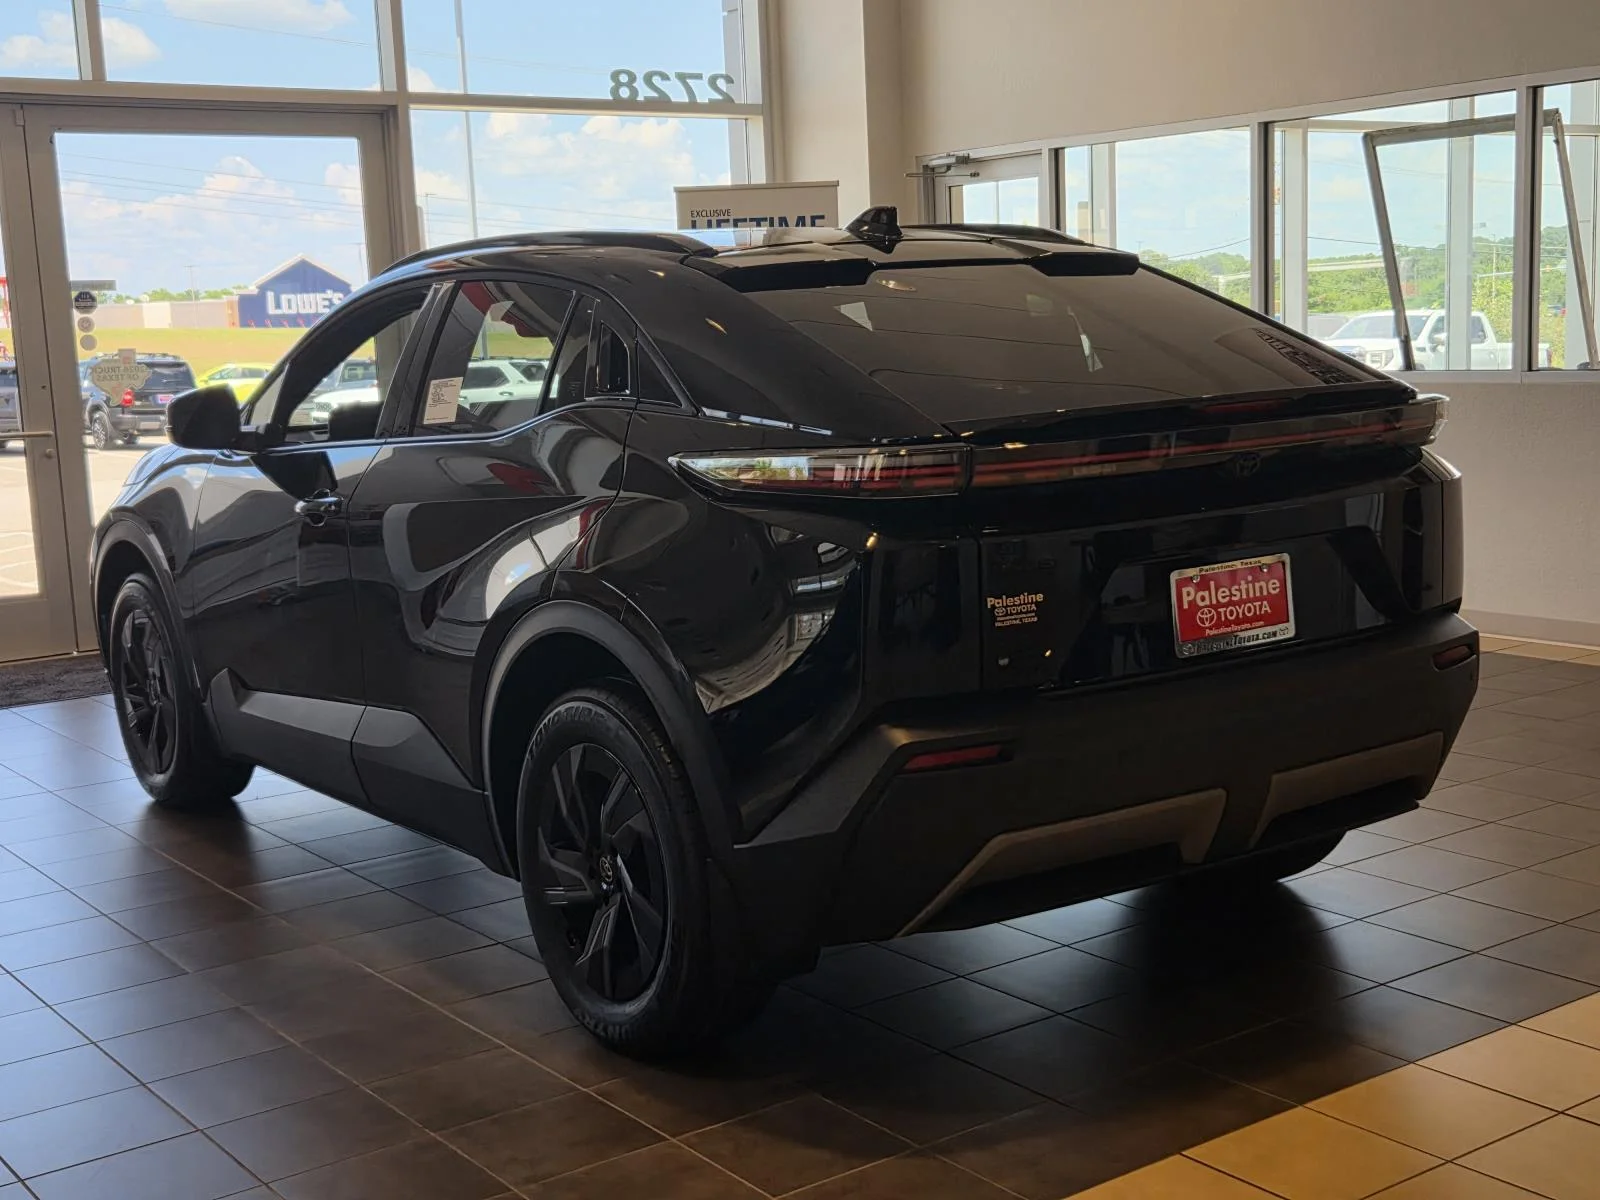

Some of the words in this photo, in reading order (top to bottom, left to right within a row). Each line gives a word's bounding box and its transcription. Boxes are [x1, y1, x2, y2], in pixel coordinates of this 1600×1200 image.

[690, 209, 732, 218] EXCLUSIVE
[987, 592, 1044, 608] Palestine
[1182, 575, 1280, 609] Palestine
[1007, 604, 1037, 615] TOYOTA
[1218, 601, 1271, 621] TOYOTA
